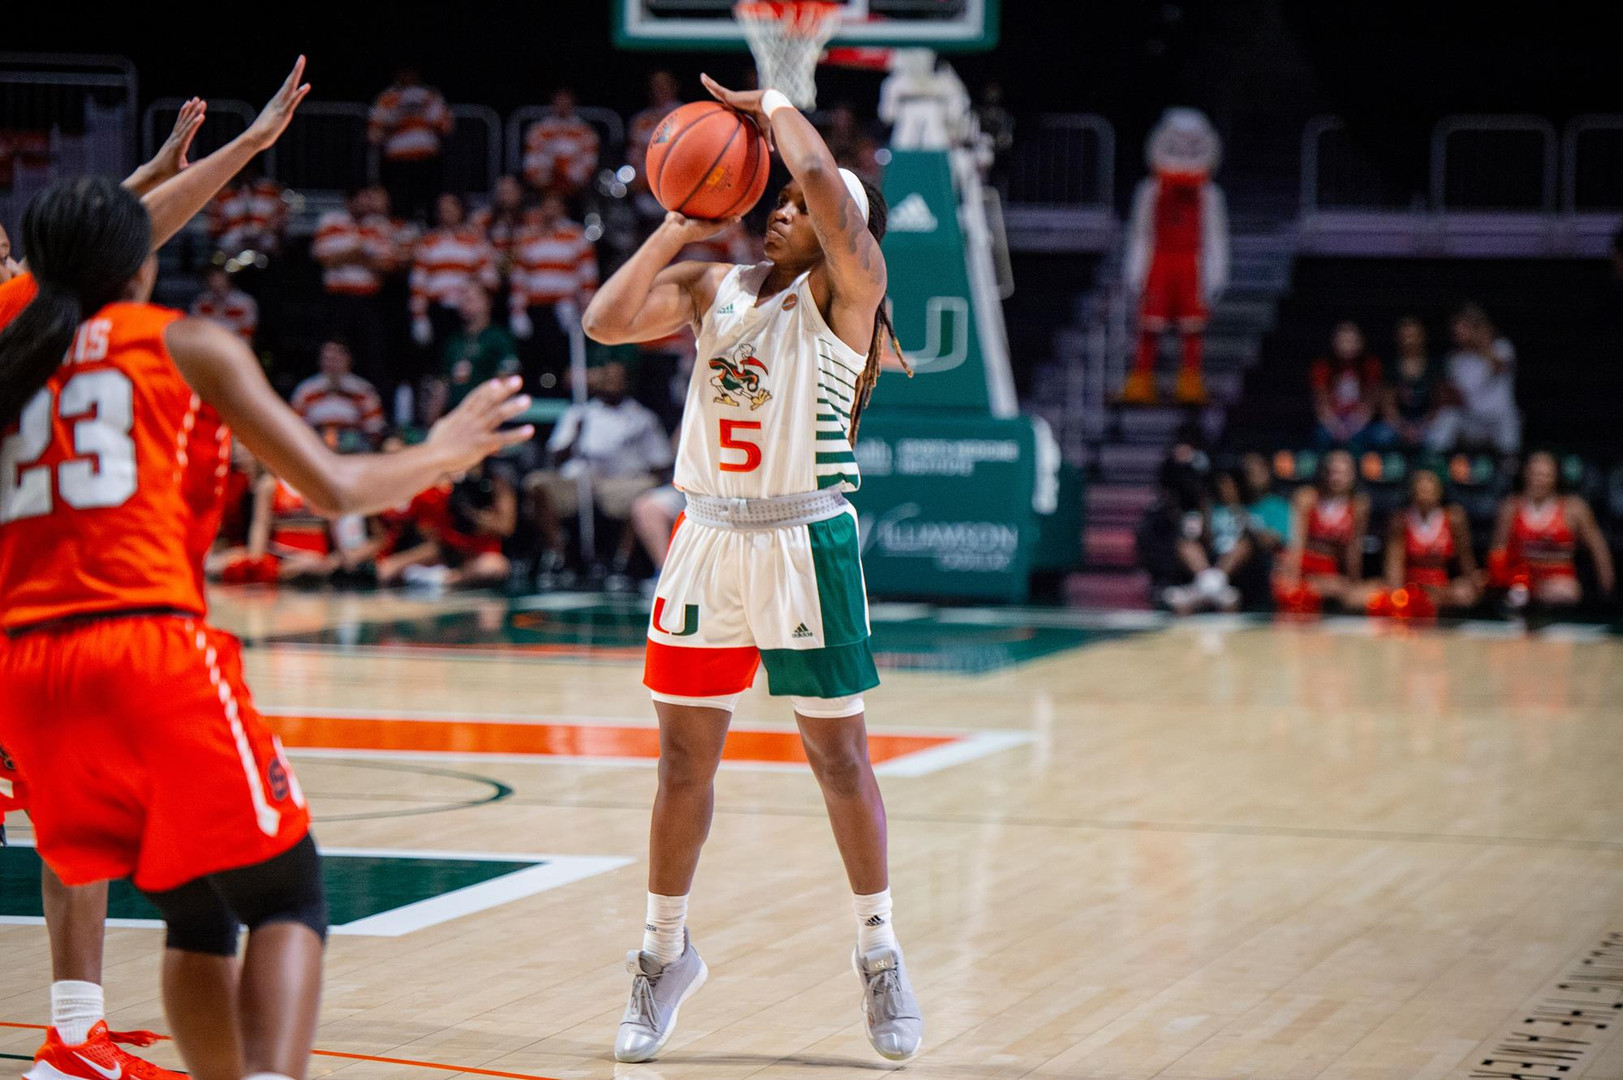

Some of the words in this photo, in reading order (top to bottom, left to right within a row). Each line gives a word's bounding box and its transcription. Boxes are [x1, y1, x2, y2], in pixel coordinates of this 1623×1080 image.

[0, 368, 138, 524] 23
[719, 418, 763, 472] 5
[652, 596, 700, 637] U
